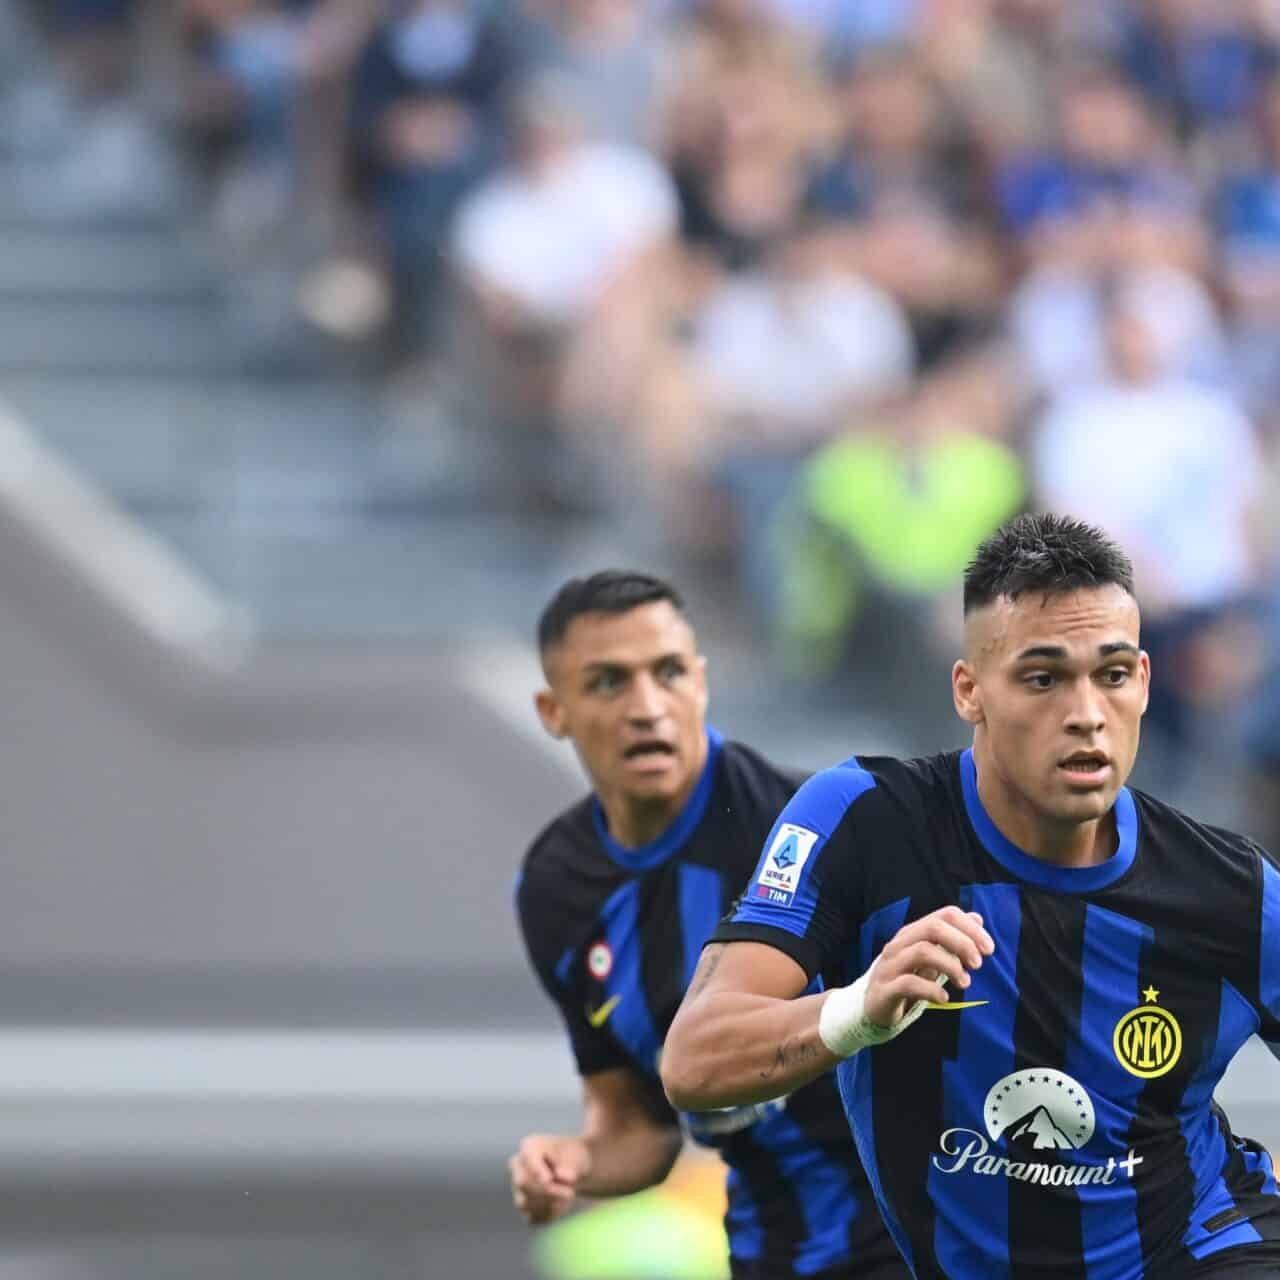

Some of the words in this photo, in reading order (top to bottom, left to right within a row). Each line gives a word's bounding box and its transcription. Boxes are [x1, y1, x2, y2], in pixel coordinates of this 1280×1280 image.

[766, 869, 784, 881] SERIE
[768, 888, 788, 903] TIM
[932, 1127, 1144, 1186] Paramount+
